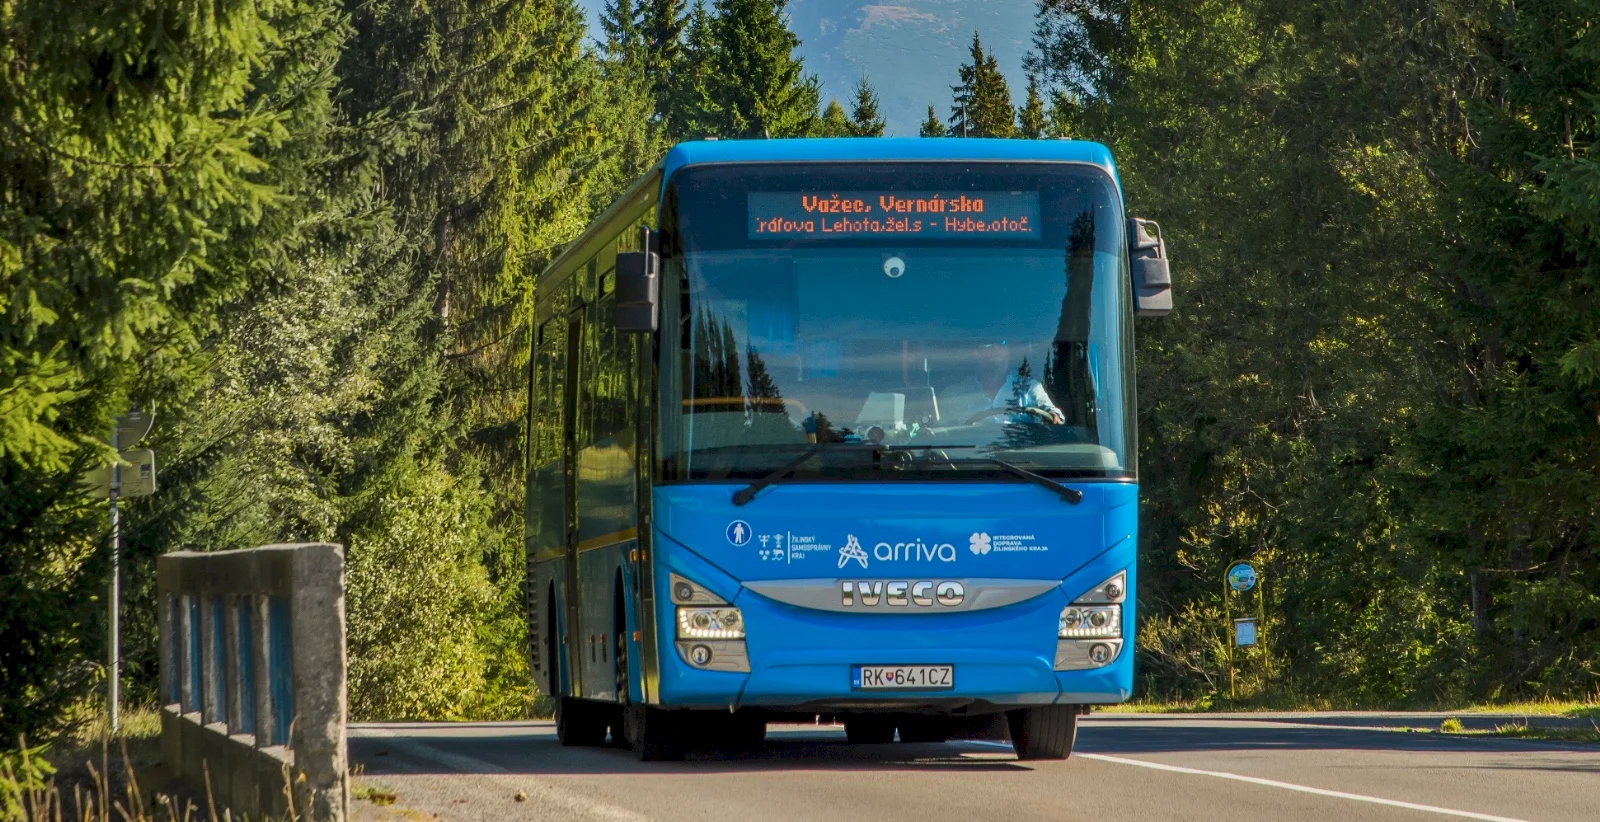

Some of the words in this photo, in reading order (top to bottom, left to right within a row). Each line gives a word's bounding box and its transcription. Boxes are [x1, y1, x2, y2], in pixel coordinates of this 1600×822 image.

[802, 194, 872, 213] Važec,
[879, 193, 984, 213] Vernárska
[791, 552, 806, 560] KRAJ
[873, 537, 957, 562] arriva
[841, 580, 965, 607] IVECO
[863, 668, 885, 686] RK
[894, 668, 951, 686] 641CZ
